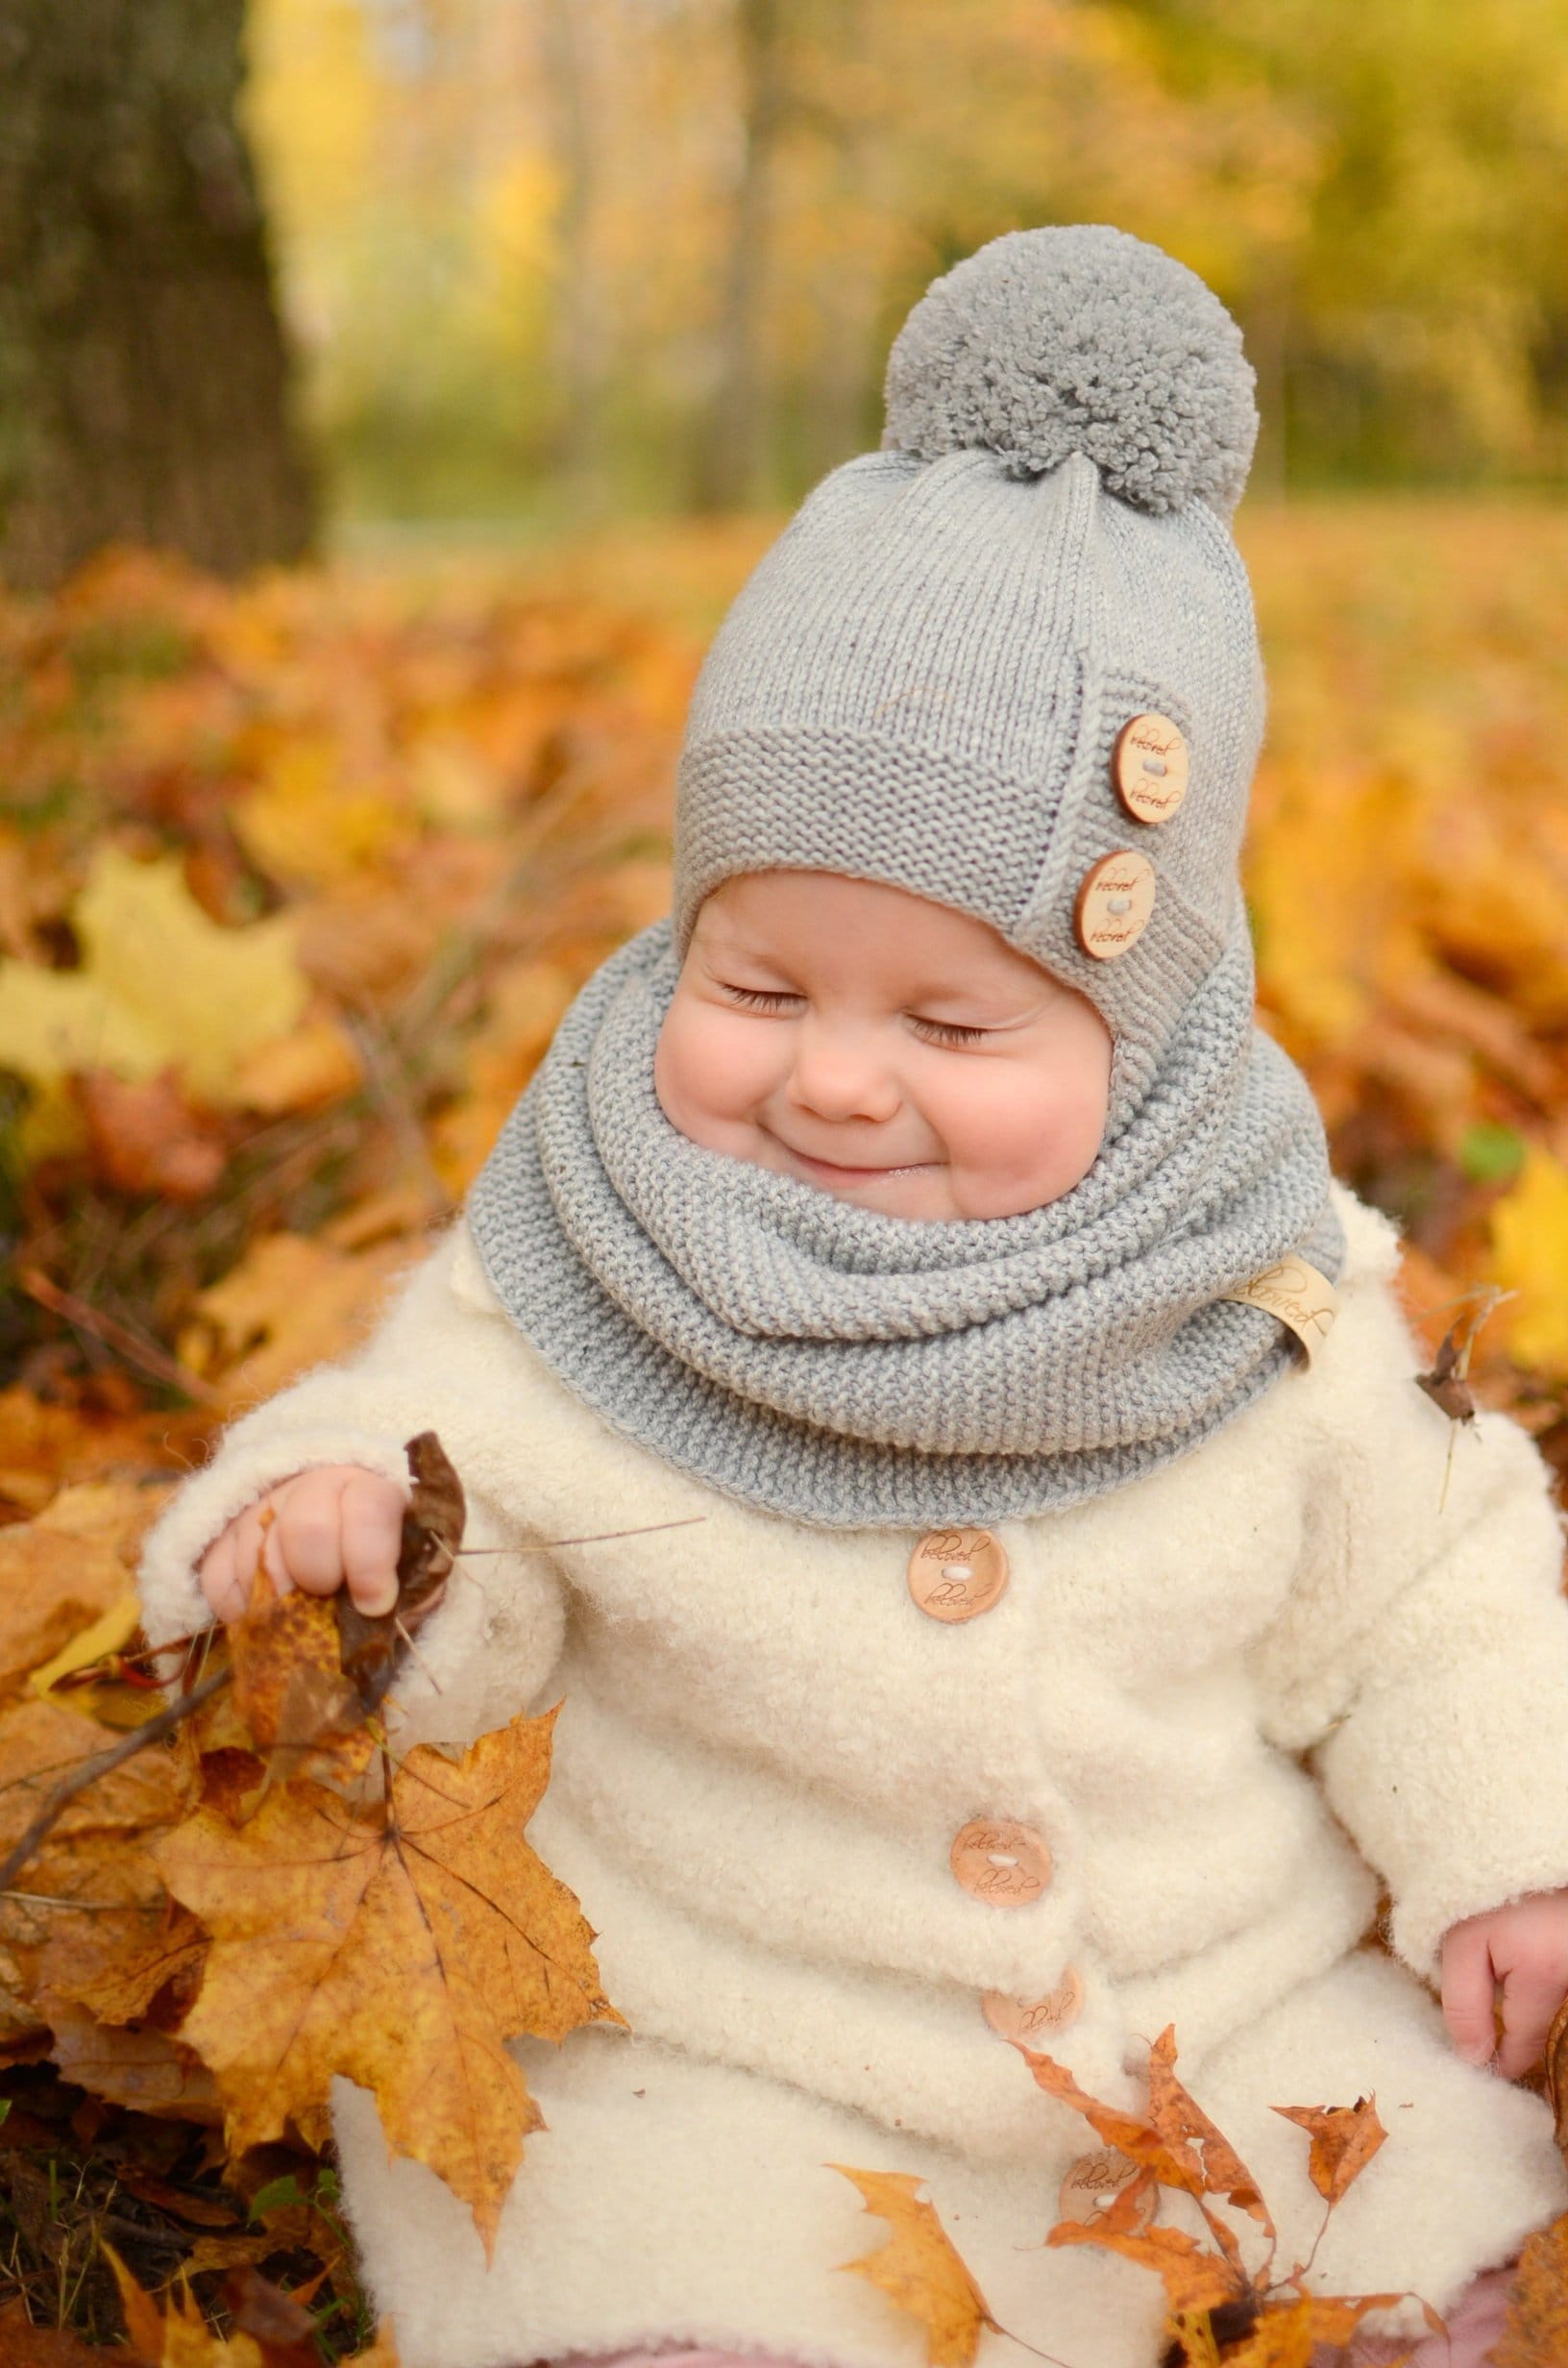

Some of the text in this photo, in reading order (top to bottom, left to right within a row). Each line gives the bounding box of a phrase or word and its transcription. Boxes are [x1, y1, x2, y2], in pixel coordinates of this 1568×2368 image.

[920, 1534, 992, 1562] beloved
[923, 1582, 993, 1607] beloved
[973, 1868, 1040, 1896] beloved
